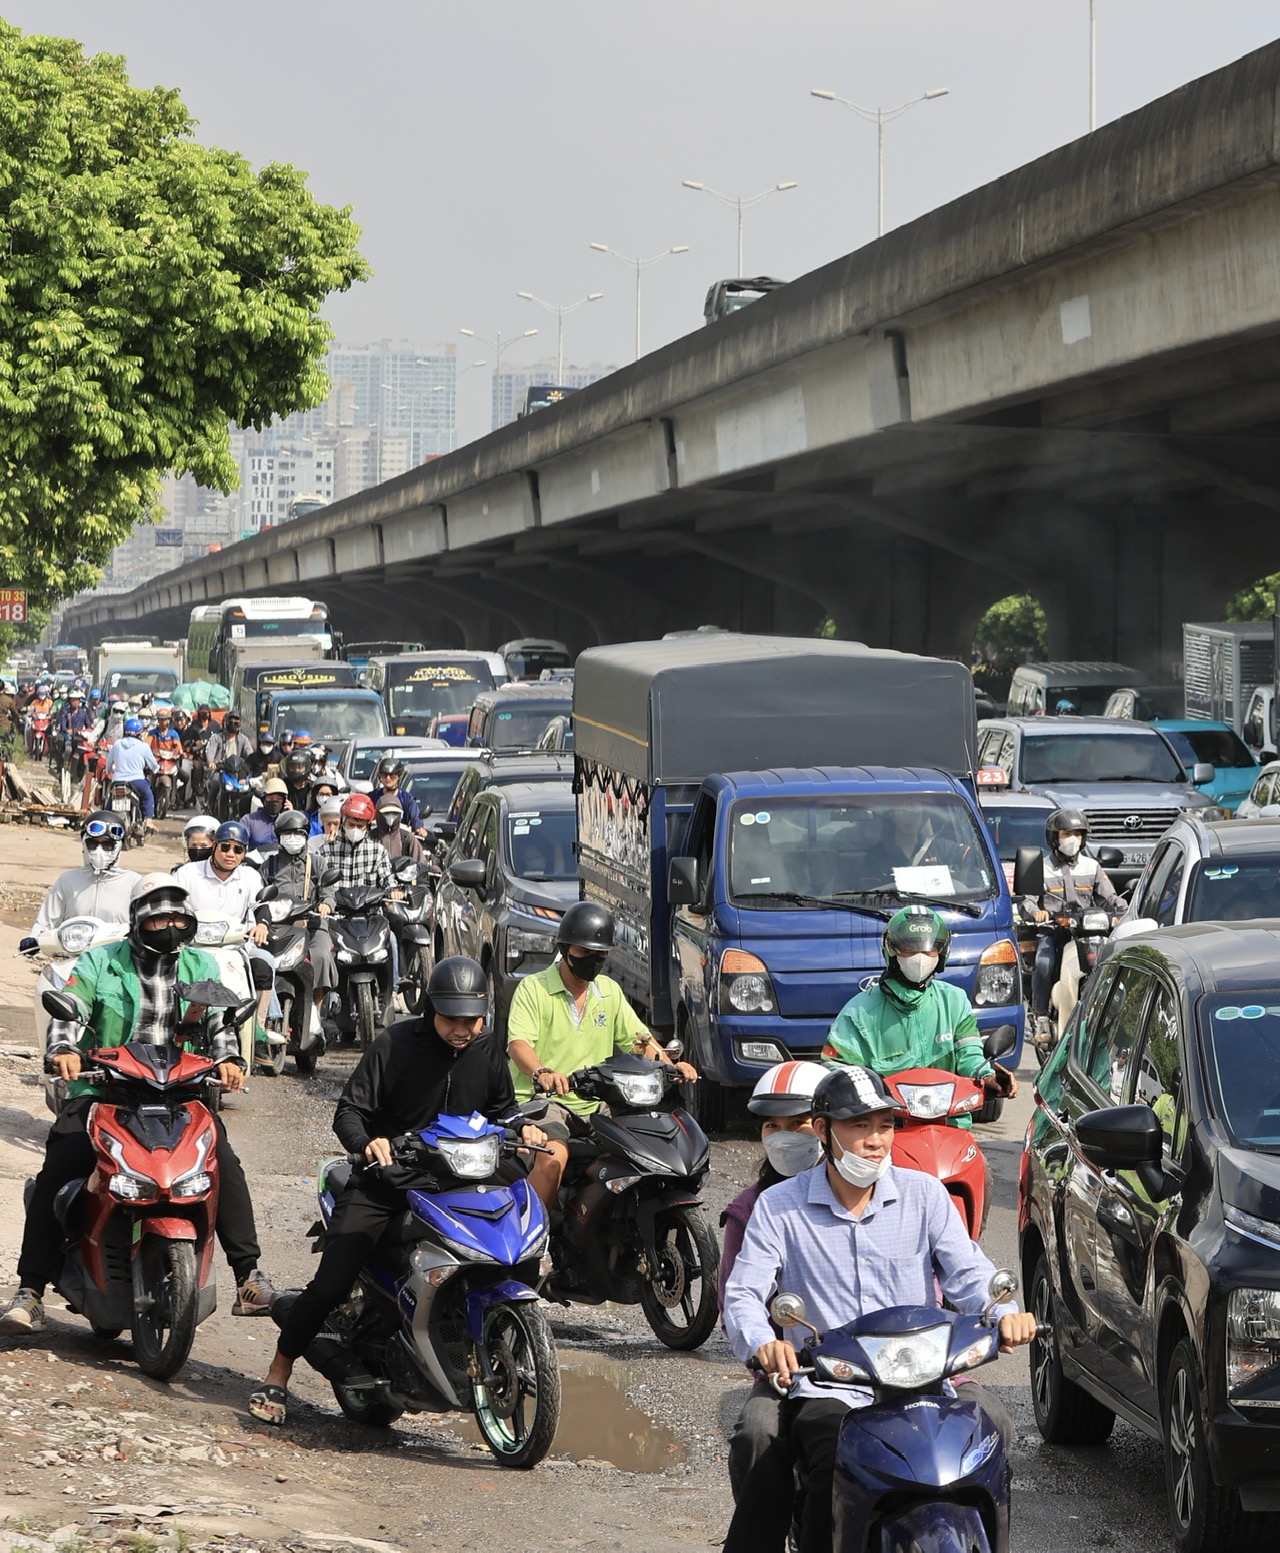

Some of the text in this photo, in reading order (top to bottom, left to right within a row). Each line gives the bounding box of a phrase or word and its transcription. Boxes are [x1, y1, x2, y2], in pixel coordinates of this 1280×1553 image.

[13, 590, 25, 601] 3S
[0, 603, 24, 621] 18
[263, 672, 337, 682] LIMOUSINE
[909, 924, 933, 933] Grab
[935, 1032, 953, 1044] Gra
[903, 1401, 941, 1411] HONDA
